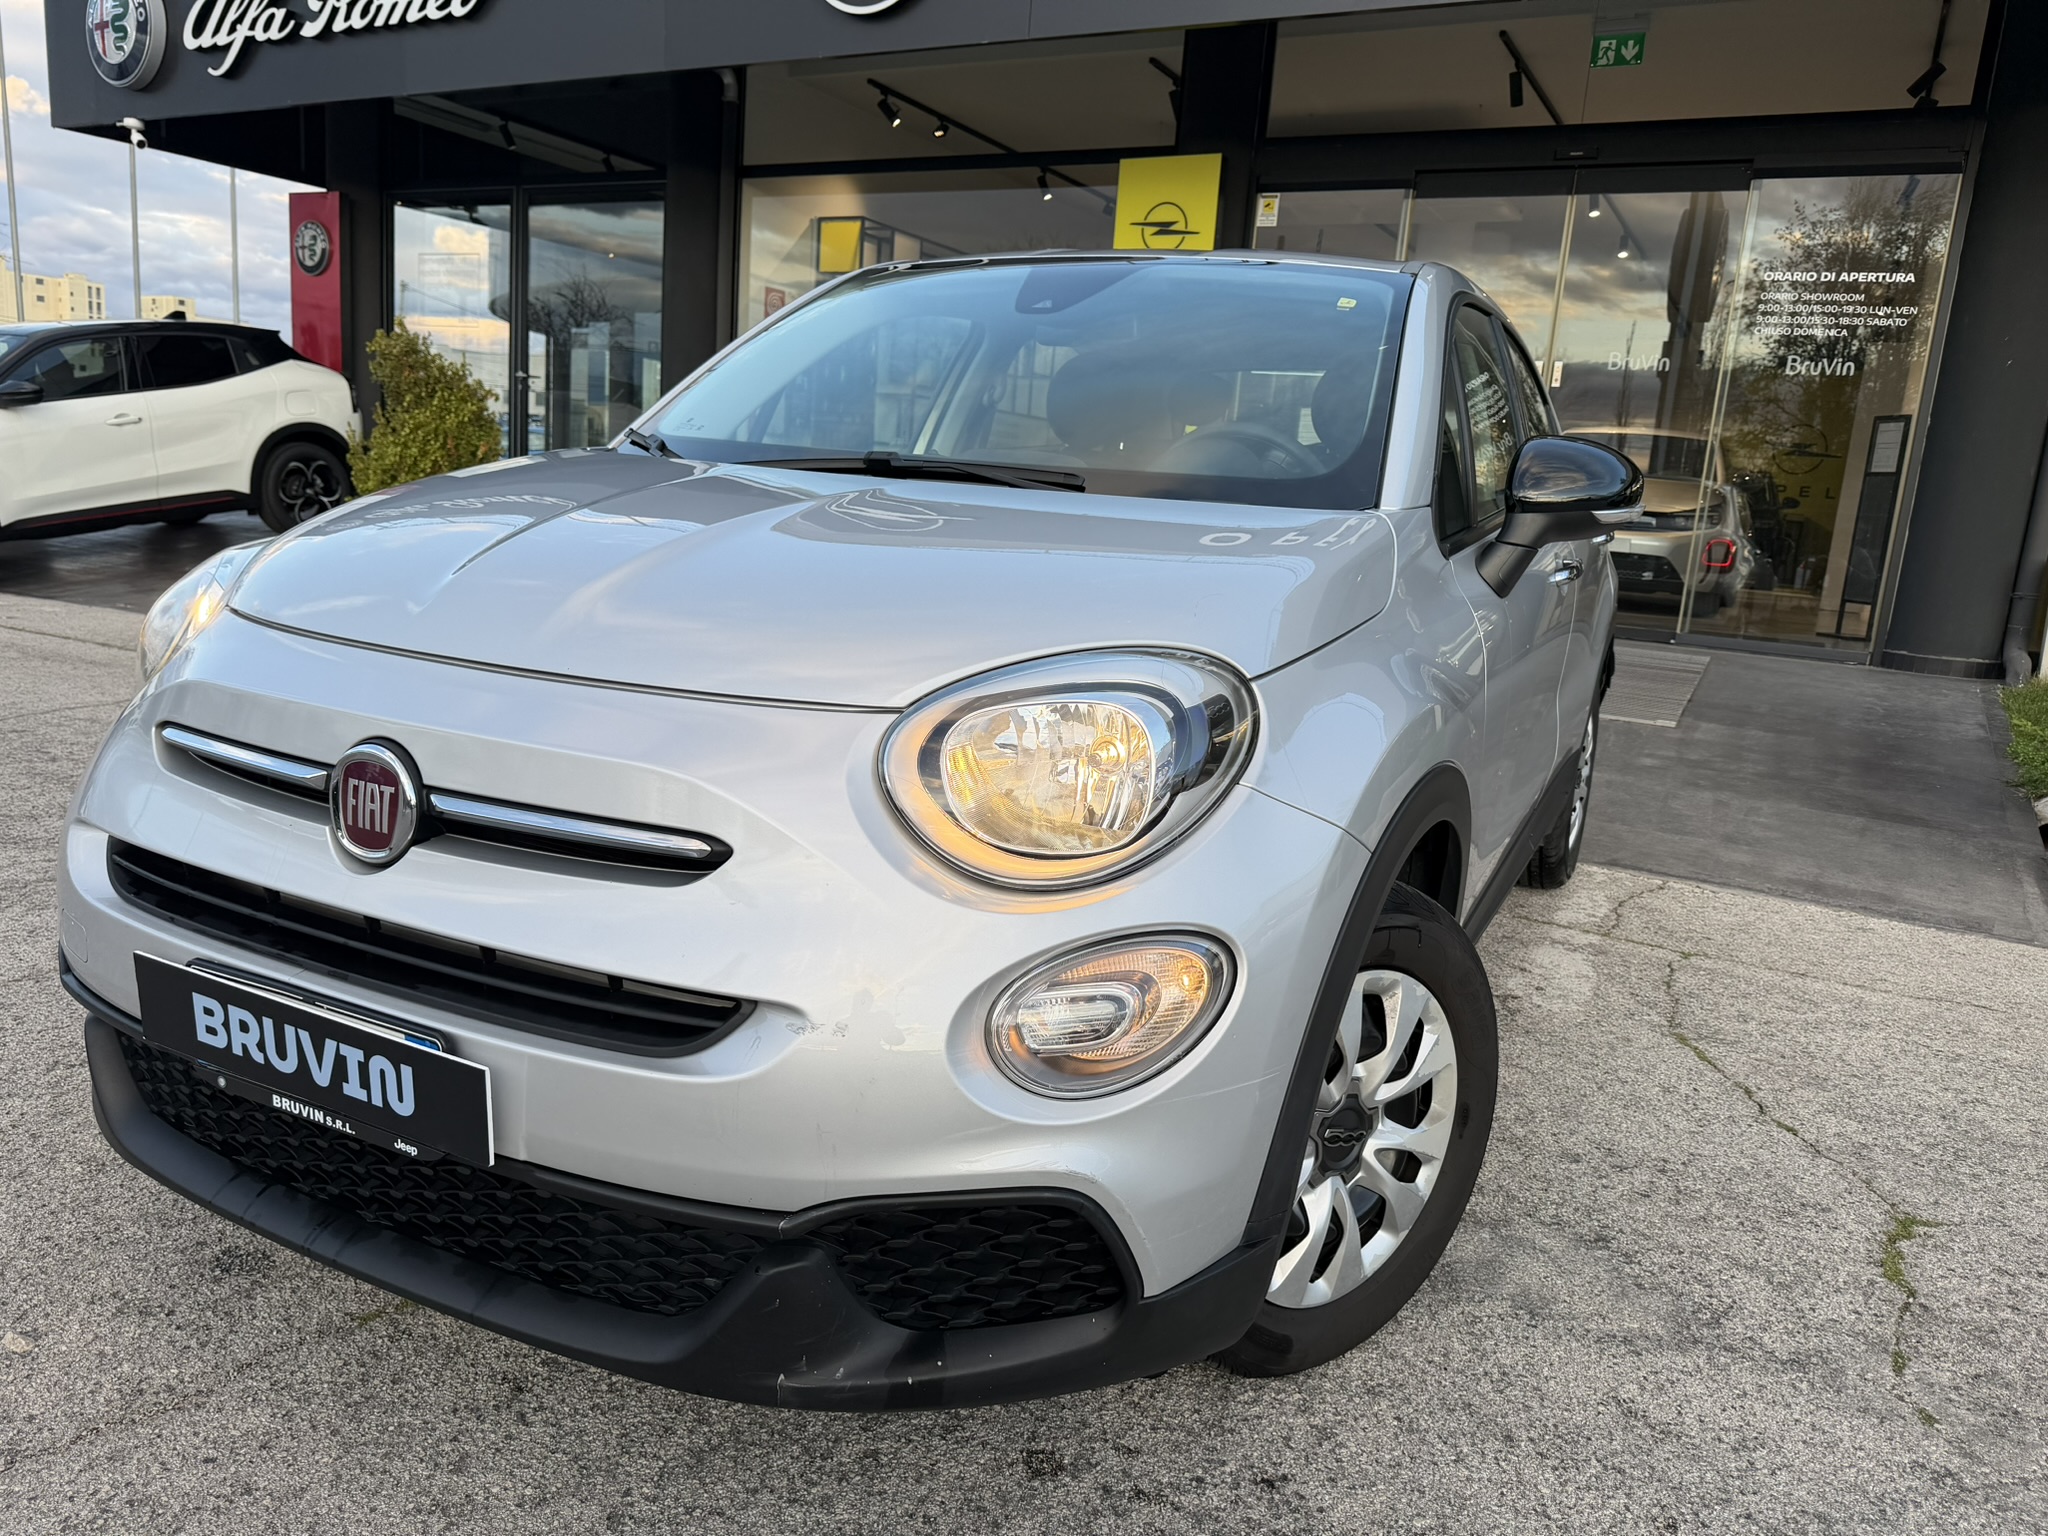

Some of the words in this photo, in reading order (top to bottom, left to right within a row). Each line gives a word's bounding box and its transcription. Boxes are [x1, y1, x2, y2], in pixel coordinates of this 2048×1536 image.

[183, 0, 295, 76] Alfa
[1763, 271, 1817, 282] ORARIO
[1820, 271, 1836, 282] DI
[1838, 272, 1916, 283] APERTURA
[1760, 292, 1799, 300] ORARIO
[1800, 292, 1865, 302] SHOWROOM
[1869, 306, 1919, 316] LUN-VEN
[1754, 327, 1792, 336] CHIUSO
[1793, 327, 1849, 337] DOMENICA
[1866, 317, 1908, 327] SABATO
[1607, 351, 1671, 373] BruVin
[1785, 355, 1856, 377] BruVin
[346, 777, 396, 835] FIAT
[191, 991, 416, 1117] BRUVIN
[272, 1094, 325, 1124] BRUVIN
[325, 1115, 357, 1135] S.R.L.
[394, 1138, 418, 1157] Jeep
